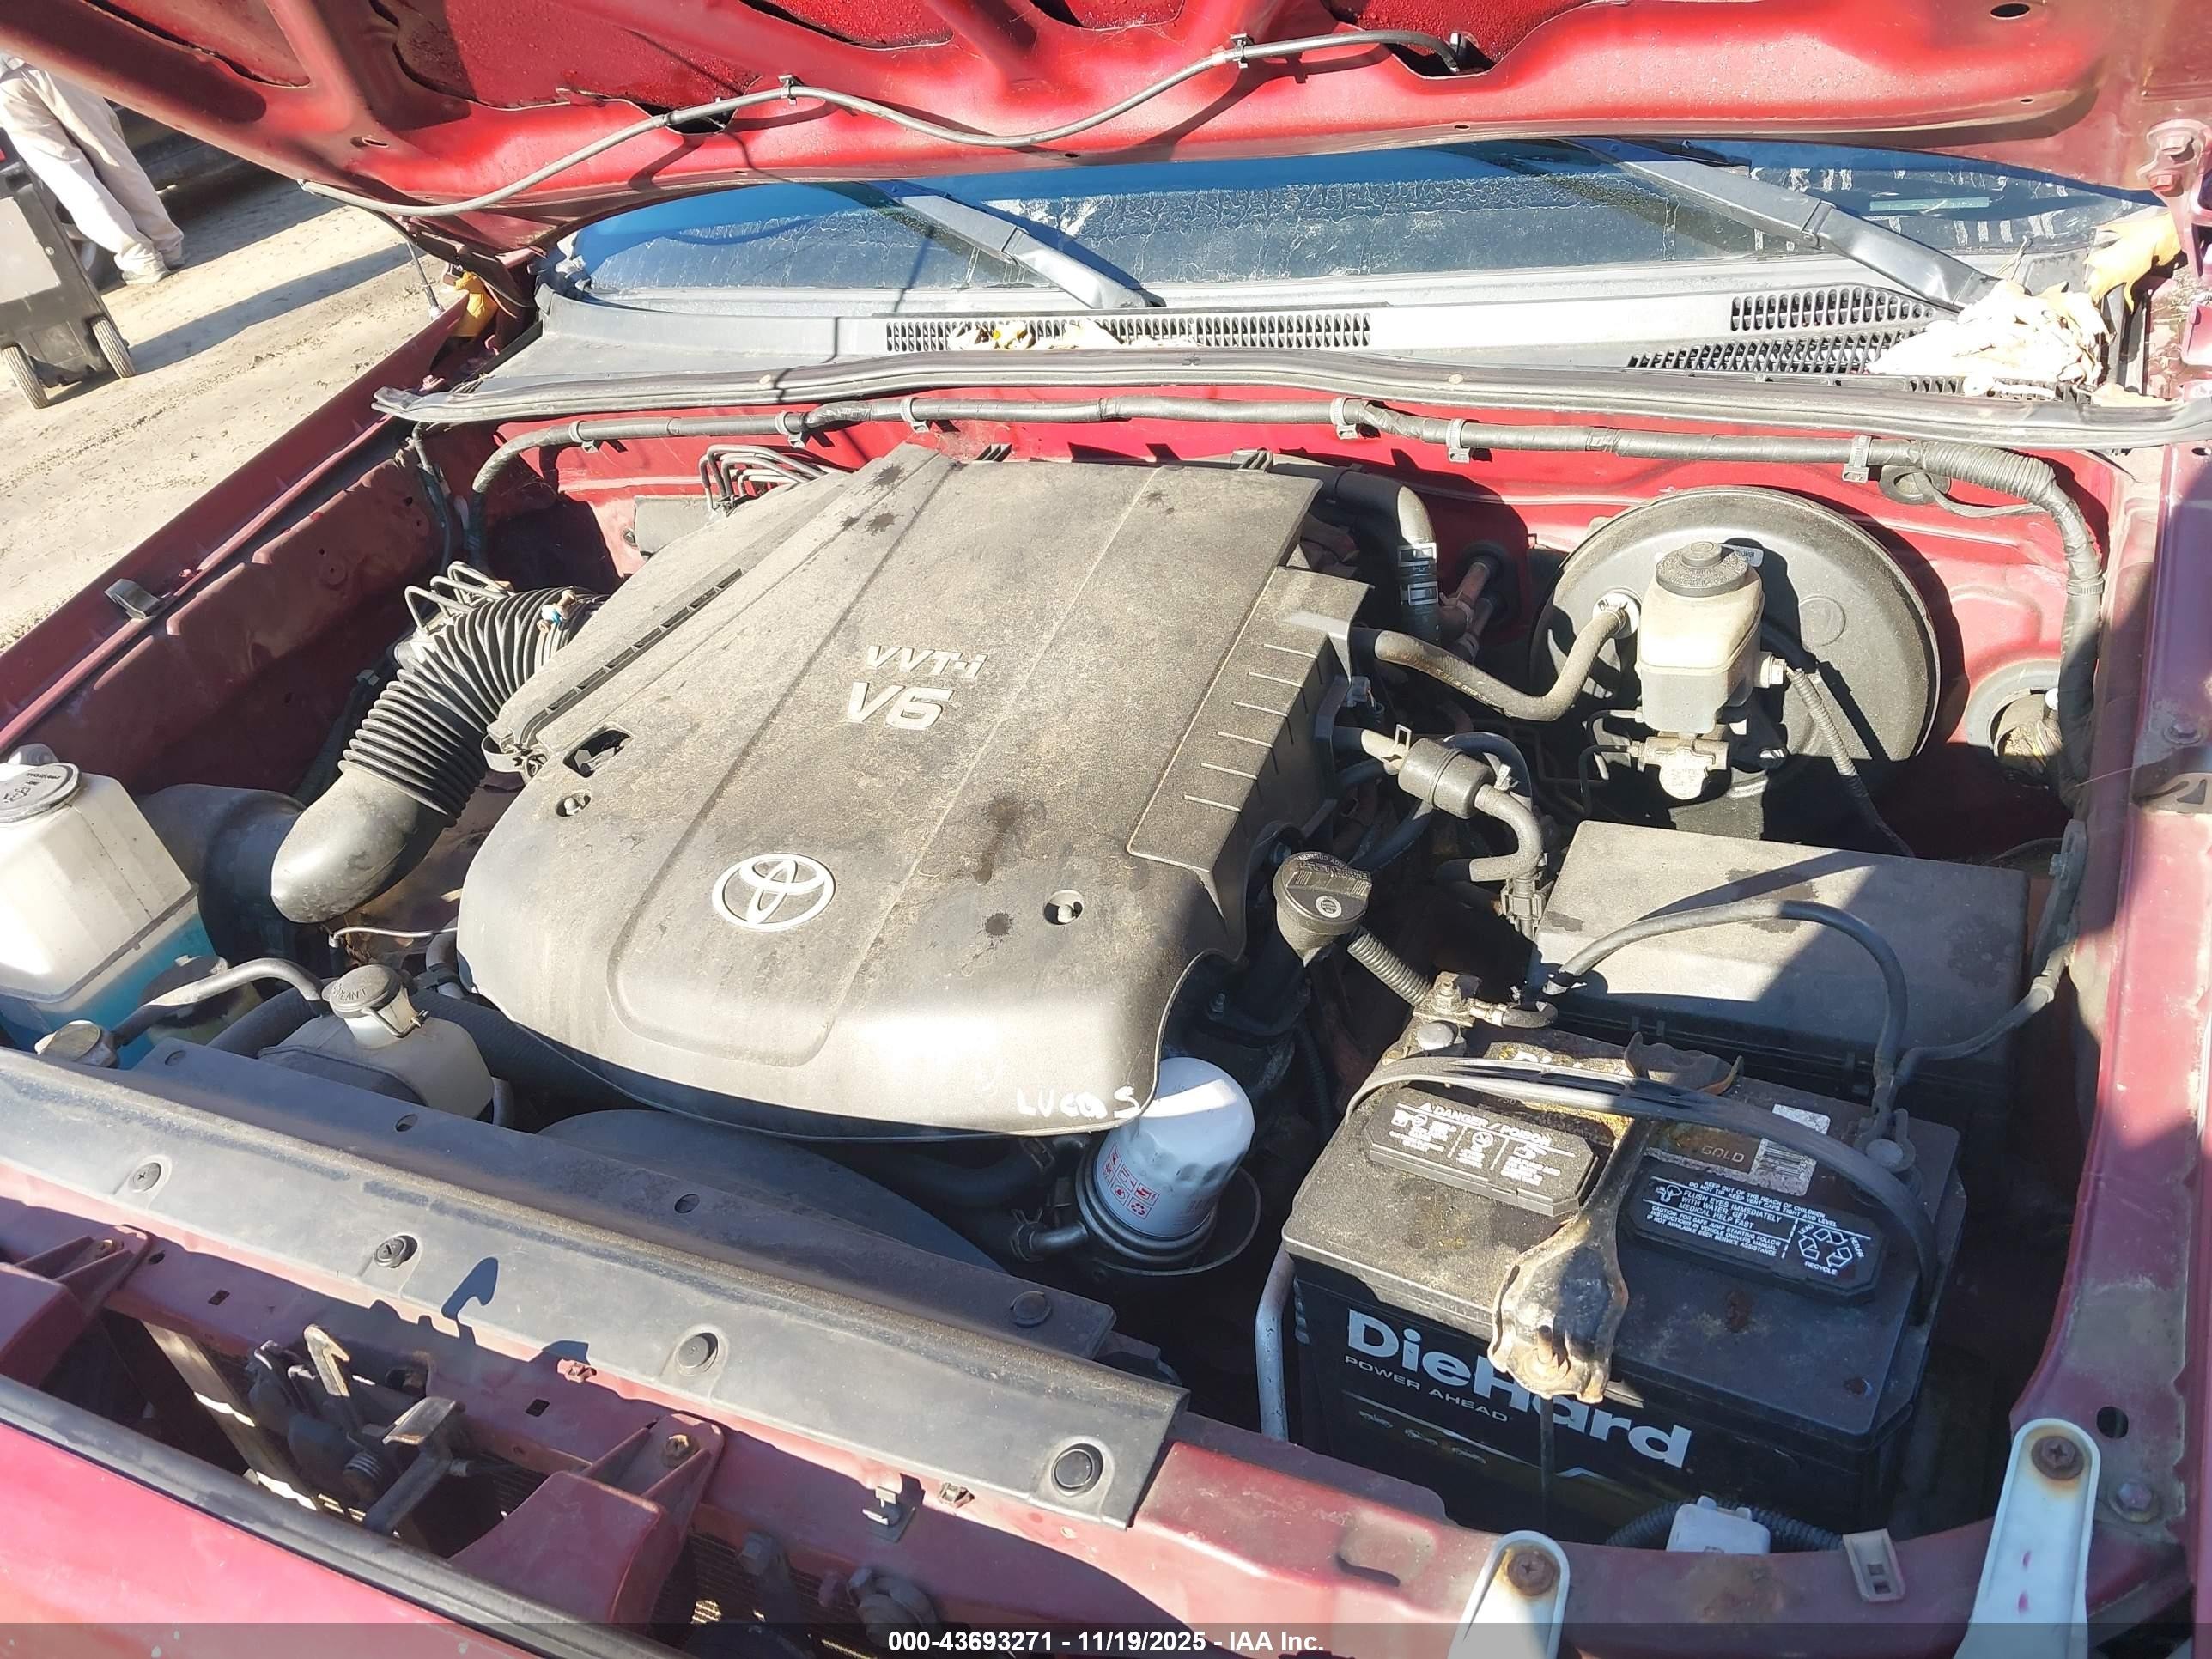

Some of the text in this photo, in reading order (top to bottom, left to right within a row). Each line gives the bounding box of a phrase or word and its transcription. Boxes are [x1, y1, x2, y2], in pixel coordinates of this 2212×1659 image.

[847, 681, 955, 730] V6
[1433, 1106, 1489, 1127] DANGER
[1500, 1125, 1552, 1147] POISON
[1701, 1146, 1745, 1163] GOLD
[1682, 1197, 1701, 1206] WITH
[1684, 1190, 1782, 1223] FLUSH EYES IMMEDIATELY
[1761, 1196, 1782, 1206] REACH
[1794, 1206, 1826, 1218] CHILDREN
[1650, 1211, 1692, 1226] INSTRUCTIONS
[1700, 1225, 1725, 1237] VEHICLE
[1678, 1202, 1754, 1229] MEDICAL HELP FAST
[1764, 1202, 1780, 1211] CAPS
[1783, 1207, 1802, 1216] TIGHT
[1817, 1218, 1838, 1227] LEVEL
[1667, 1221, 1698, 1234] AVAILABLE
[1698, 1230, 1714, 1238] SEEK
[1715, 1235, 1739, 1246] SERVICE
[1740, 1242, 1778, 1256] ASSISTANCE
[1726, 1227, 1755, 1238] STARTING
[1757, 1237, 1782, 1247] FOLLOW
[1798, 1224, 1814, 1235] LEAD
[1850, 1237, 1864, 1258] RETURN
[1804, 1261, 1839, 1276] RECYCLE
[1345, 1355, 1510, 1423] POWER AHEAD
[1347, 1308, 1692, 1469] DieHard
